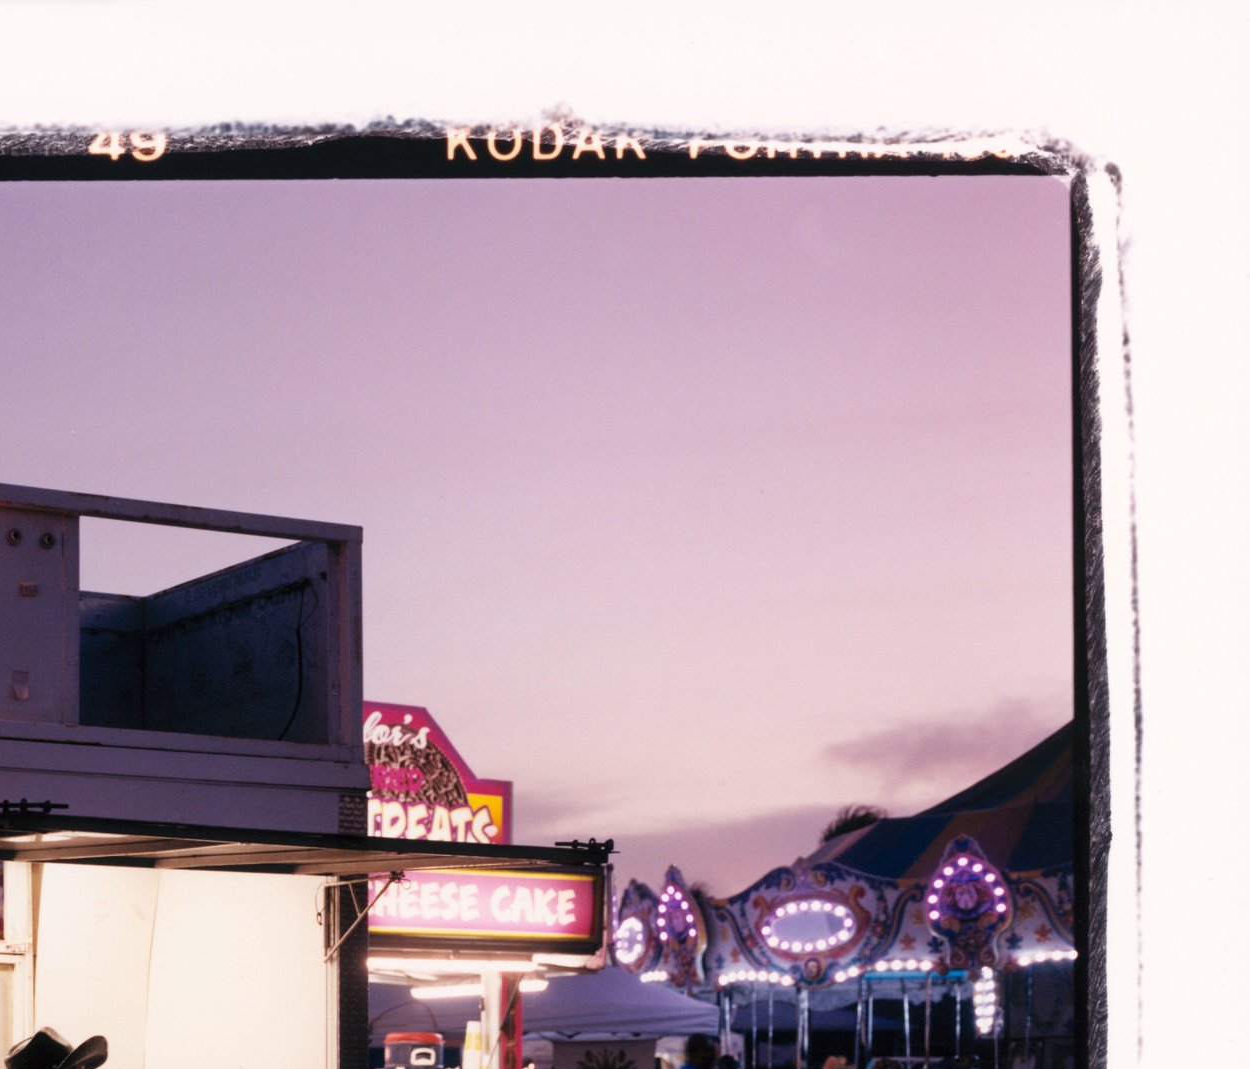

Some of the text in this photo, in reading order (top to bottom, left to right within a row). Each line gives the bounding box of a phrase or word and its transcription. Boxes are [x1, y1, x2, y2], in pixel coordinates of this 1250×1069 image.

[369, 763, 425, 793] RIED
[368, 878, 577, 927] HEESE CAKE
